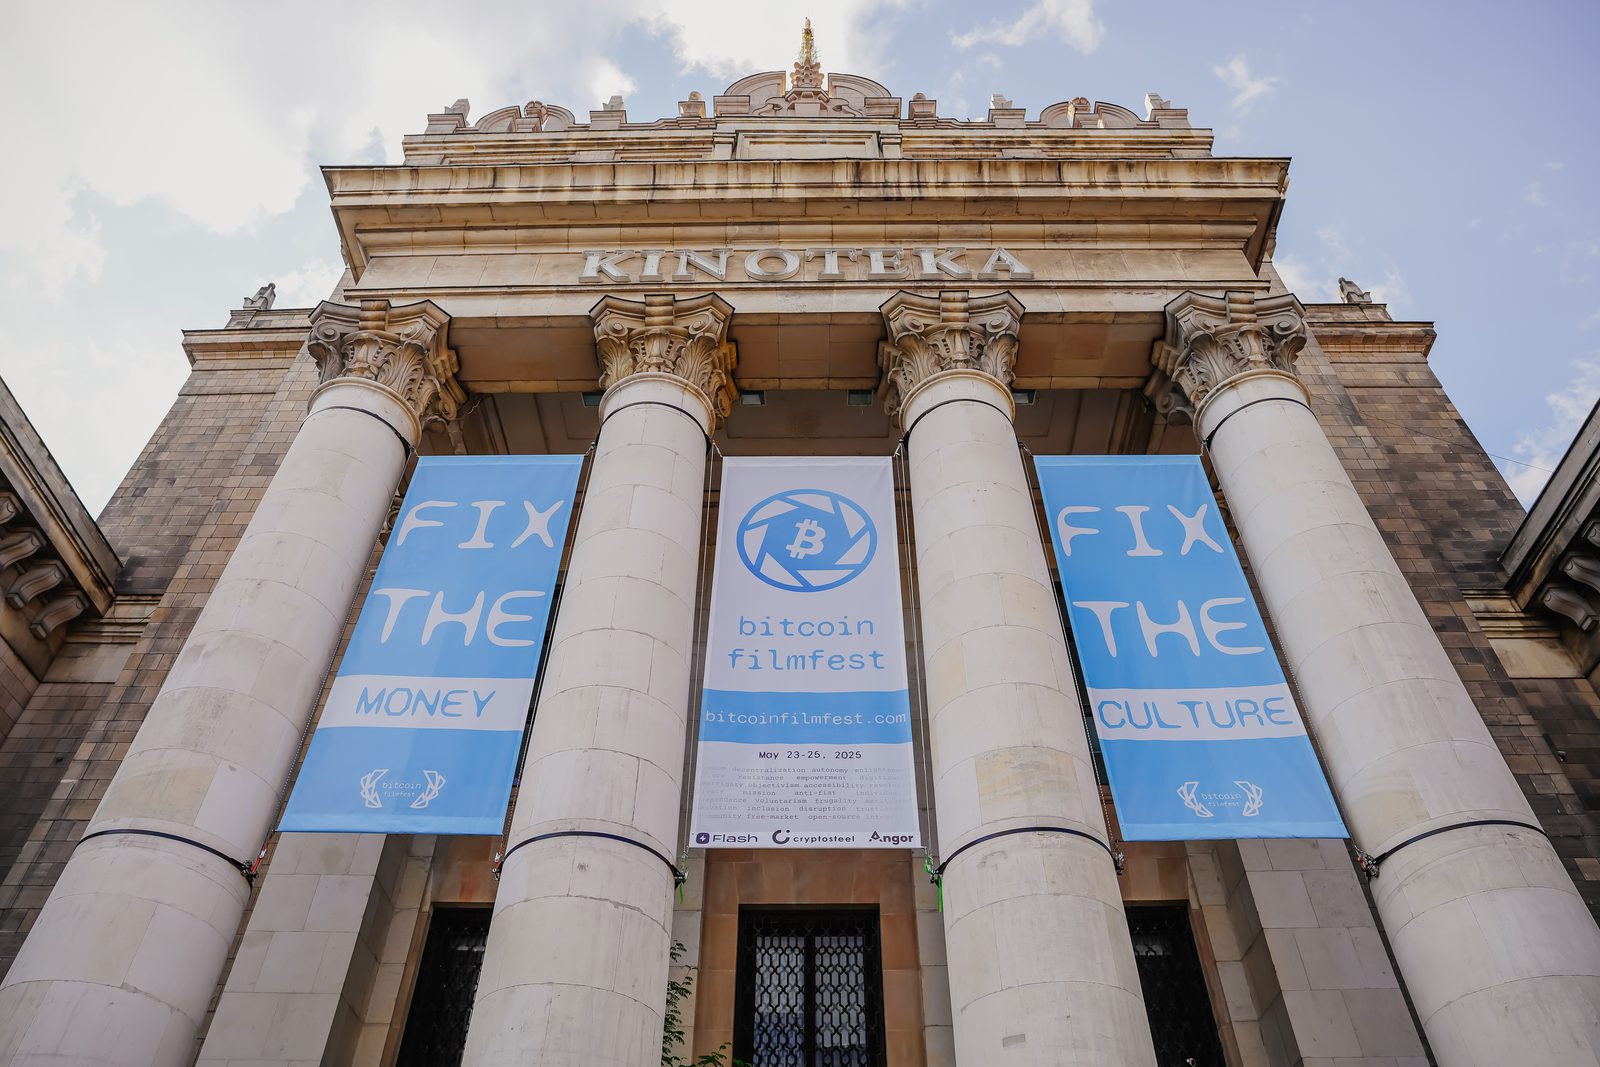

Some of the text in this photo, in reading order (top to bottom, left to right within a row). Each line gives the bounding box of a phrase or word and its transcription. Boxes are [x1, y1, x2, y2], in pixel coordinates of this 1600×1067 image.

[578, 246, 1035, 283] KINOTEKA
[396, 500, 564, 549] FIX
[1057, 504, 1224, 556] FIX
[374, 588, 546, 647] THE
[739, 616, 874, 637] bitcoin
[1072, 597, 1265, 658] THE
[728, 648, 885, 670] filmfest
[356, 687, 496, 717] MONEY
[706, 710, 906, 724] bitcoinfilmfest.com
[1098, 697, 1294, 729] CULTURE
[759, 751, 779, 760] May
[834, 751, 862, 759] 2025
[383, 781, 422, 789] bitcoin
[1202, 792, 1241, 800] bitcoin
[713, 834, 758, 844] Flash
[793, 836, 855, 844] cryptosteel
[868, 830, 914, 845] Angor
